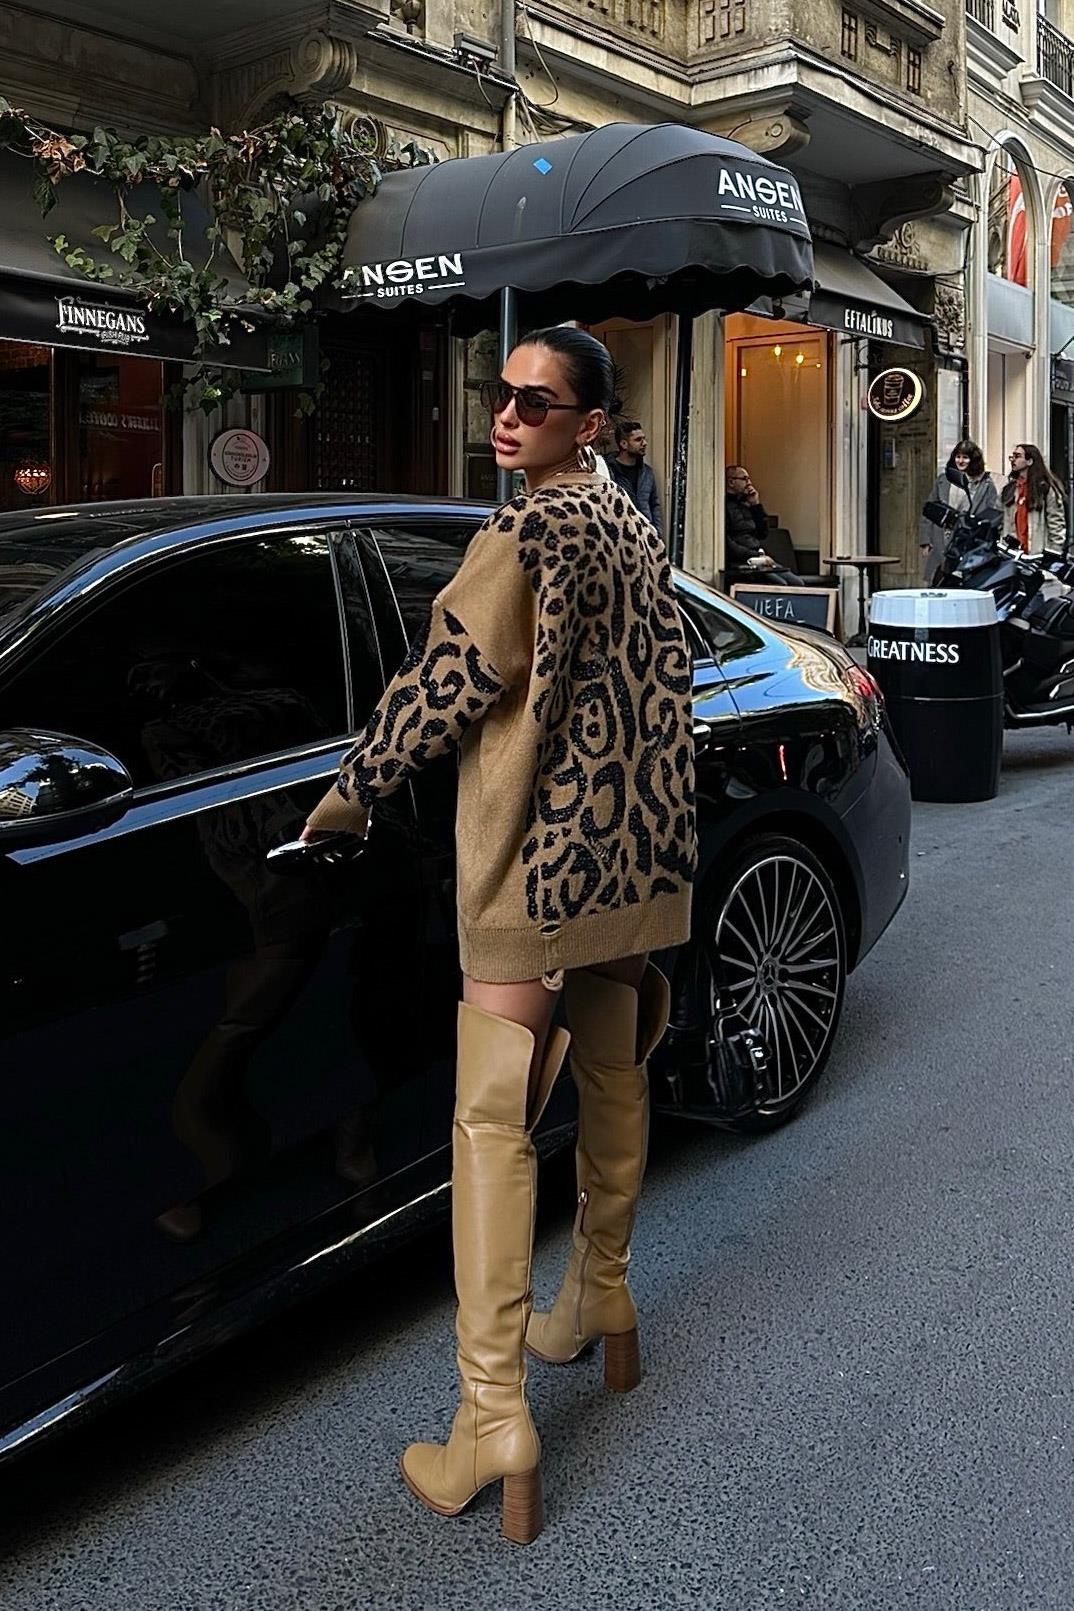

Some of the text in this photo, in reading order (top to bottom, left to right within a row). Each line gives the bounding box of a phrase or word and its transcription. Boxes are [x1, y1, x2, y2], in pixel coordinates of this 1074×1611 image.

[718, 168, 805, 215] ANSEN
[752, 205, 788, 223] SUITES
[376, 283, 424, 298] SUITES
[54, 295, 146, 334] FINNEGANS
[754, 598, 796, 619] UEFA
[867, 635, 960, 664] GREATNESS
